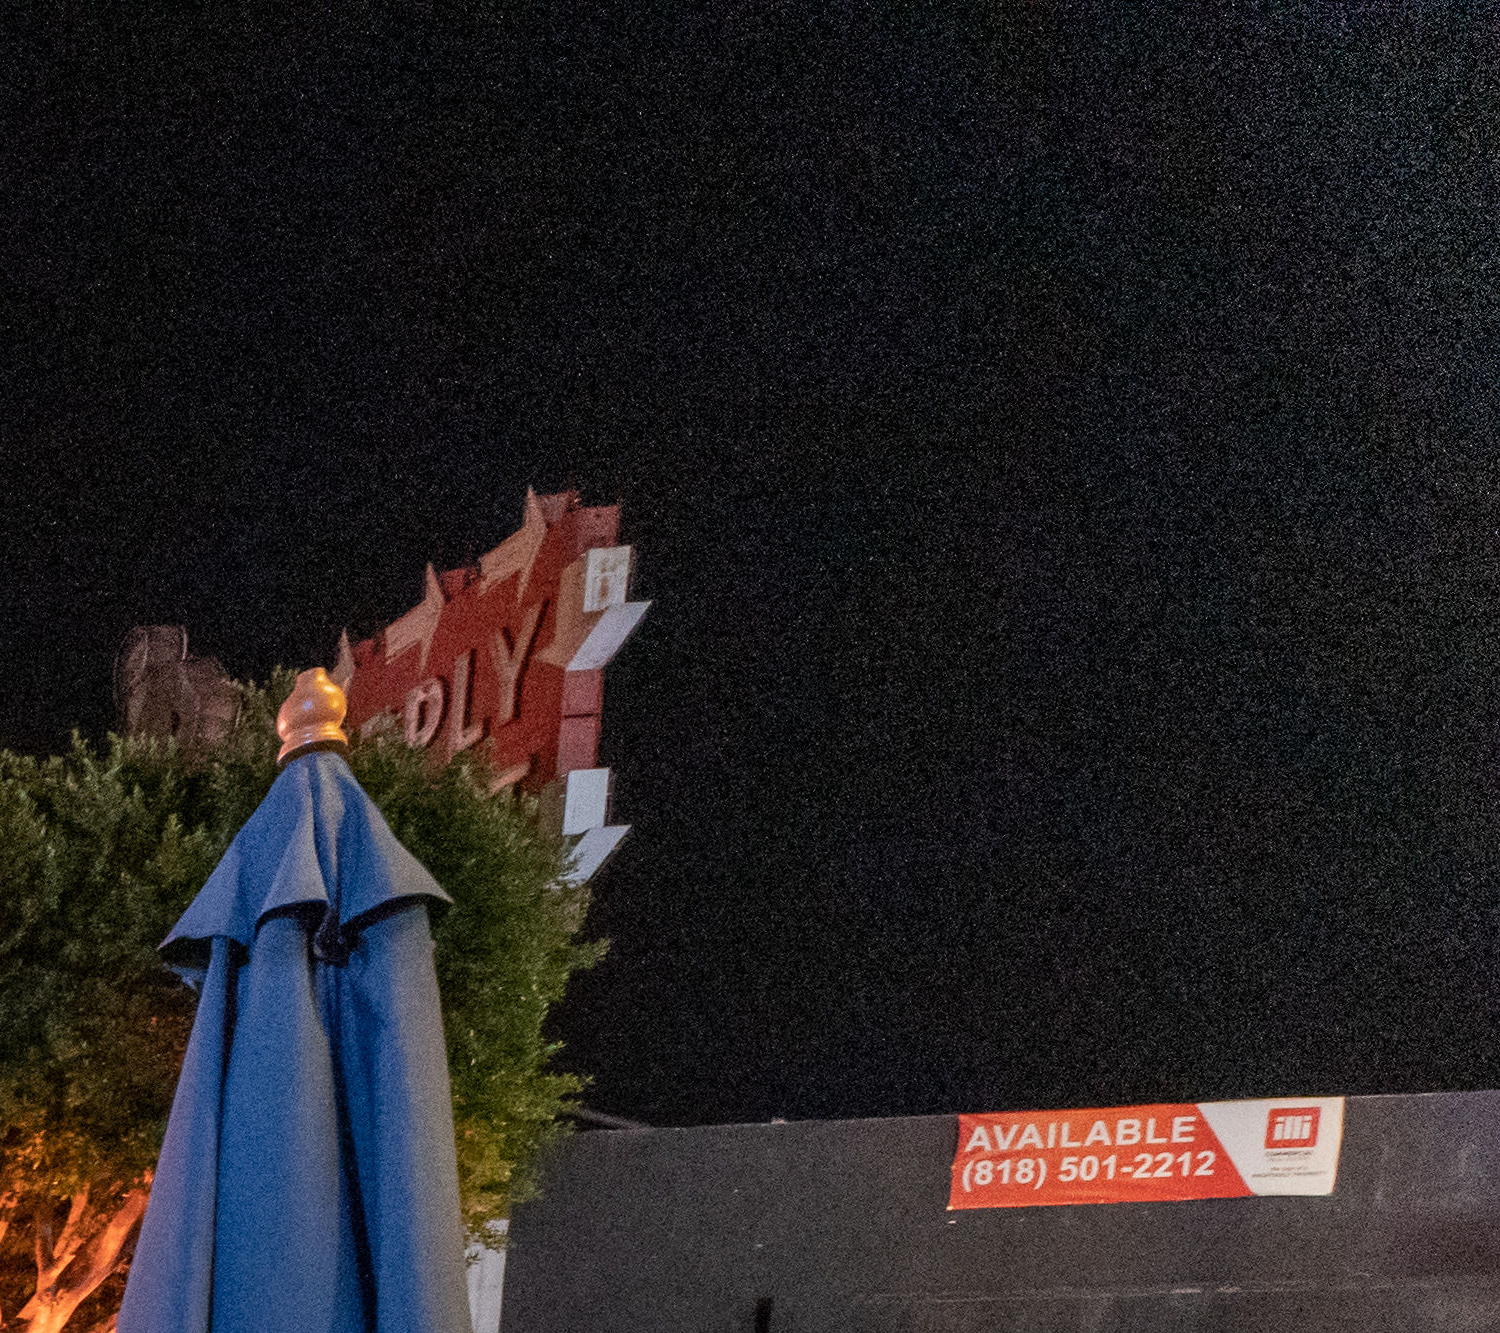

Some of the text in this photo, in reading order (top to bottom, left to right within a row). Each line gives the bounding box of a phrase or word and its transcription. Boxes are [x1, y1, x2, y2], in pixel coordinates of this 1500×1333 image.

[965, 1115, 1197, 1152] AVAILABLE
[962, 1150, 1216, 1192] (818) 501-2212
